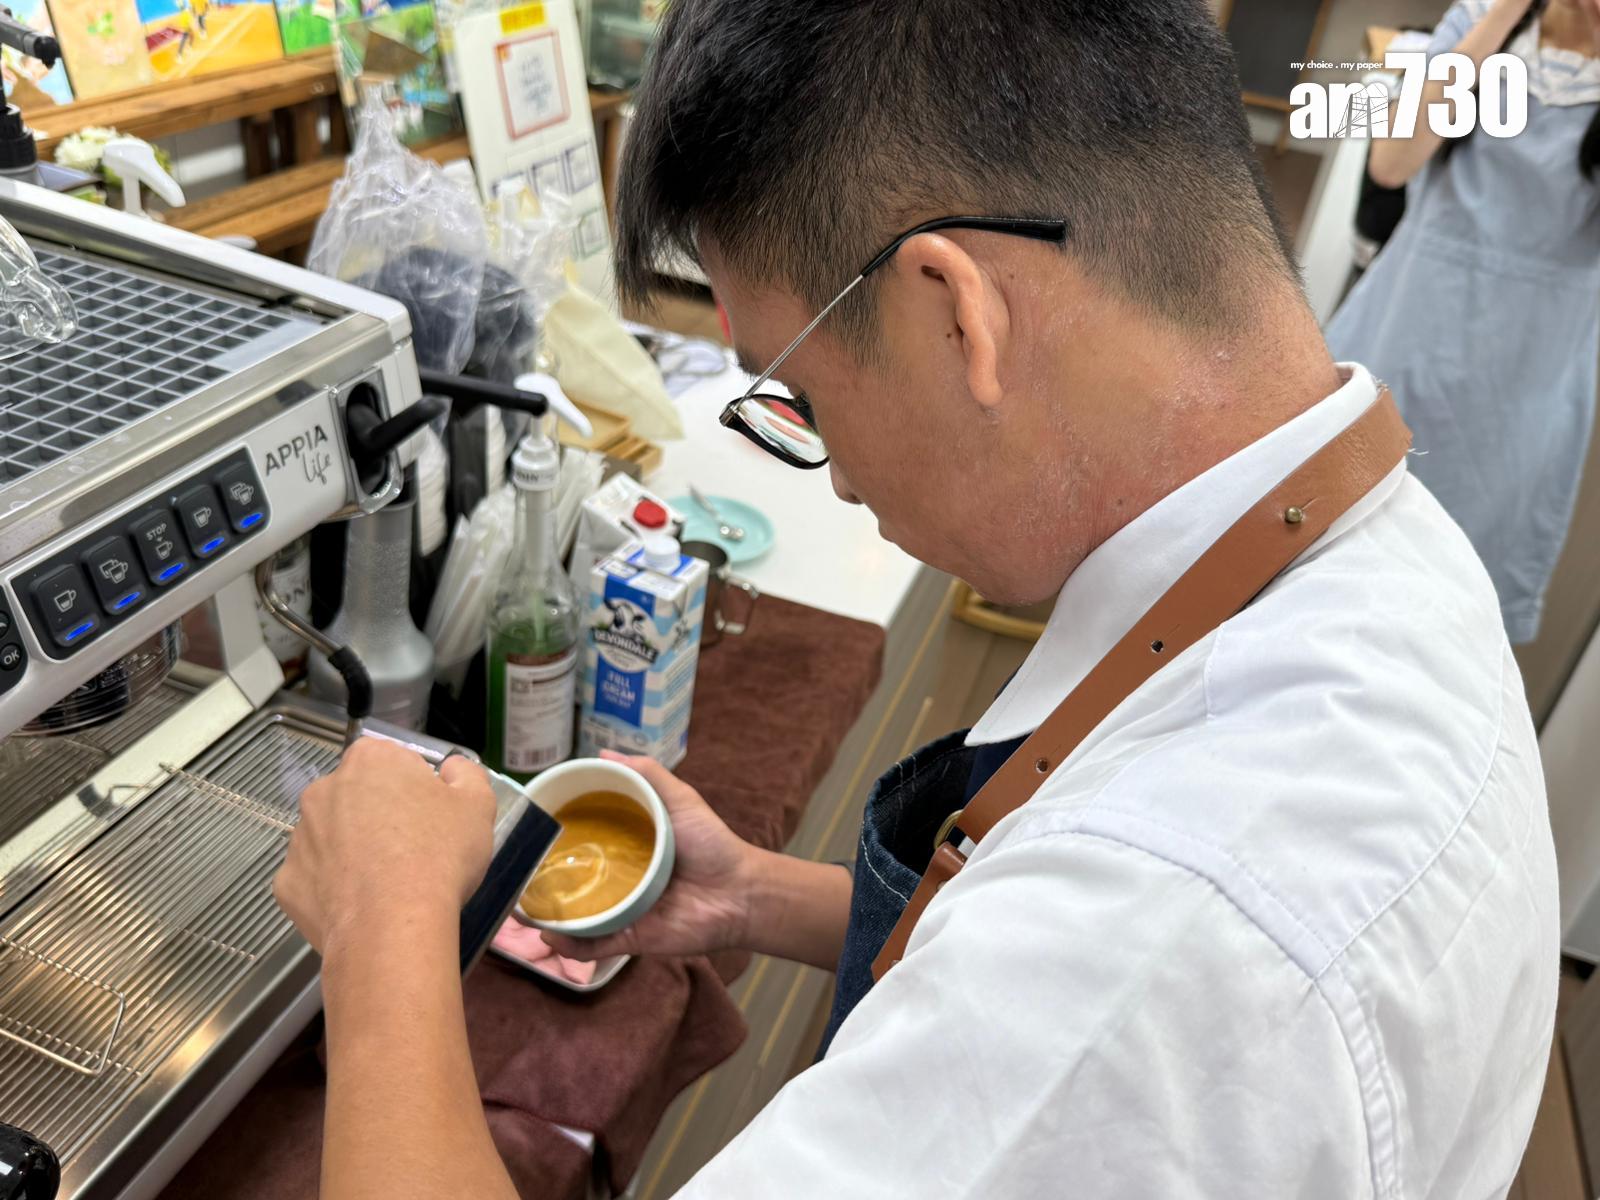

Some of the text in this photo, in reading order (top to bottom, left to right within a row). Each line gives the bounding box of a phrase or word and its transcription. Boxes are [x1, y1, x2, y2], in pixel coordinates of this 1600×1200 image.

[265, 424, 328, 477] APPIA
[146, 522, 167, 541] STOP
[3, 649, 20, 665] OK
